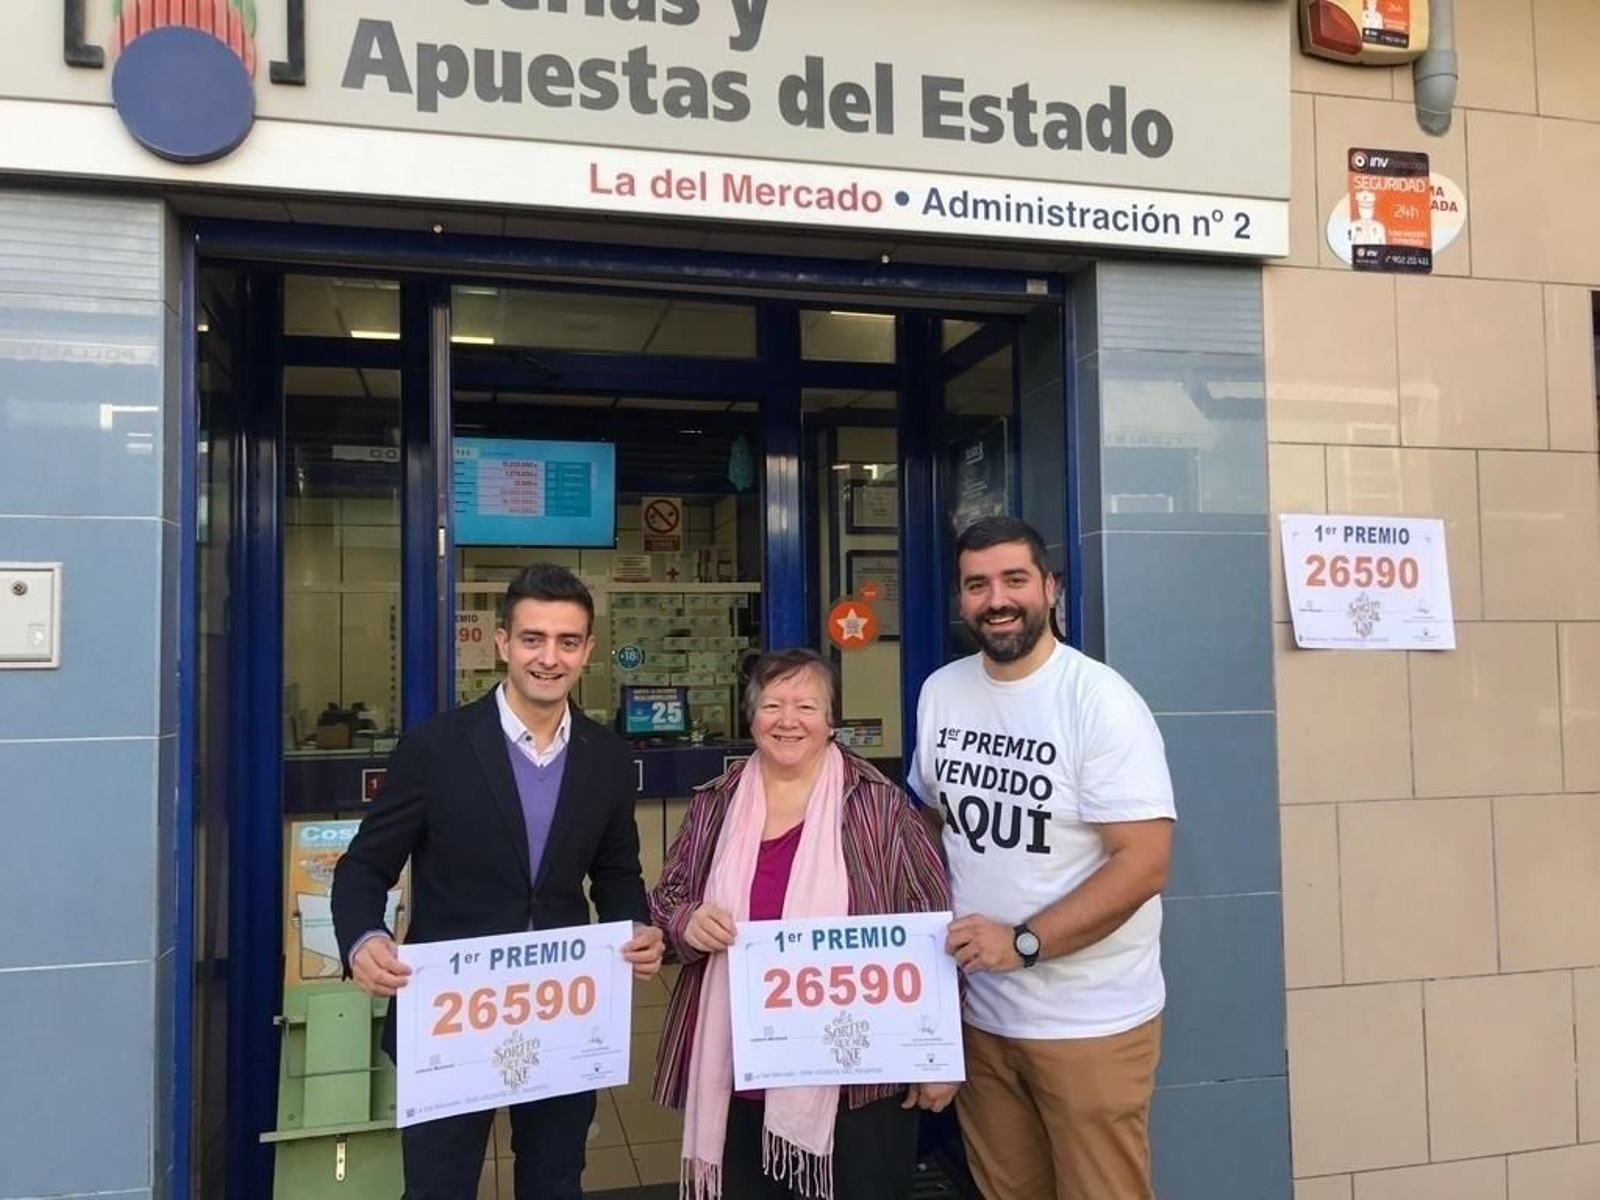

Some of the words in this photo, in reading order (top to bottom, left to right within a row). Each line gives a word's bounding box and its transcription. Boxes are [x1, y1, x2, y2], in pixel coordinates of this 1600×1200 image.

[341, 17, 751, 122] Apuestas
[778, 55, 894, 134] del
[921, 74, 1174, 159] Estado
[589, 162, 636, 197] La
[650, 168, 707, 201] del
[722, 172, 883, 213] Mercado
[922, 187, 1181, 235] Administración
[1233, 211, 1251, 240] 2
[1353, 175, 1426, 193] SEGURIDAD
[1343, 525, 1410, 545] PREMIO
[1305, 554, 1419, 589] 26590
[651, 701, 682, 724] 25
[961, 730, 1057, 766] PREMIO
[935, 757, 1053, 802] VENDIDO
[449, 951, 481, 975] 1er
[489, 938, 587, 971] PREMIO
[774, 931, 803, 953] 1er
[811, 925, 907, 951] PREMIO
[763, 962, 922, 1009] 26590
[432, 975, 596, 1037] 26590
